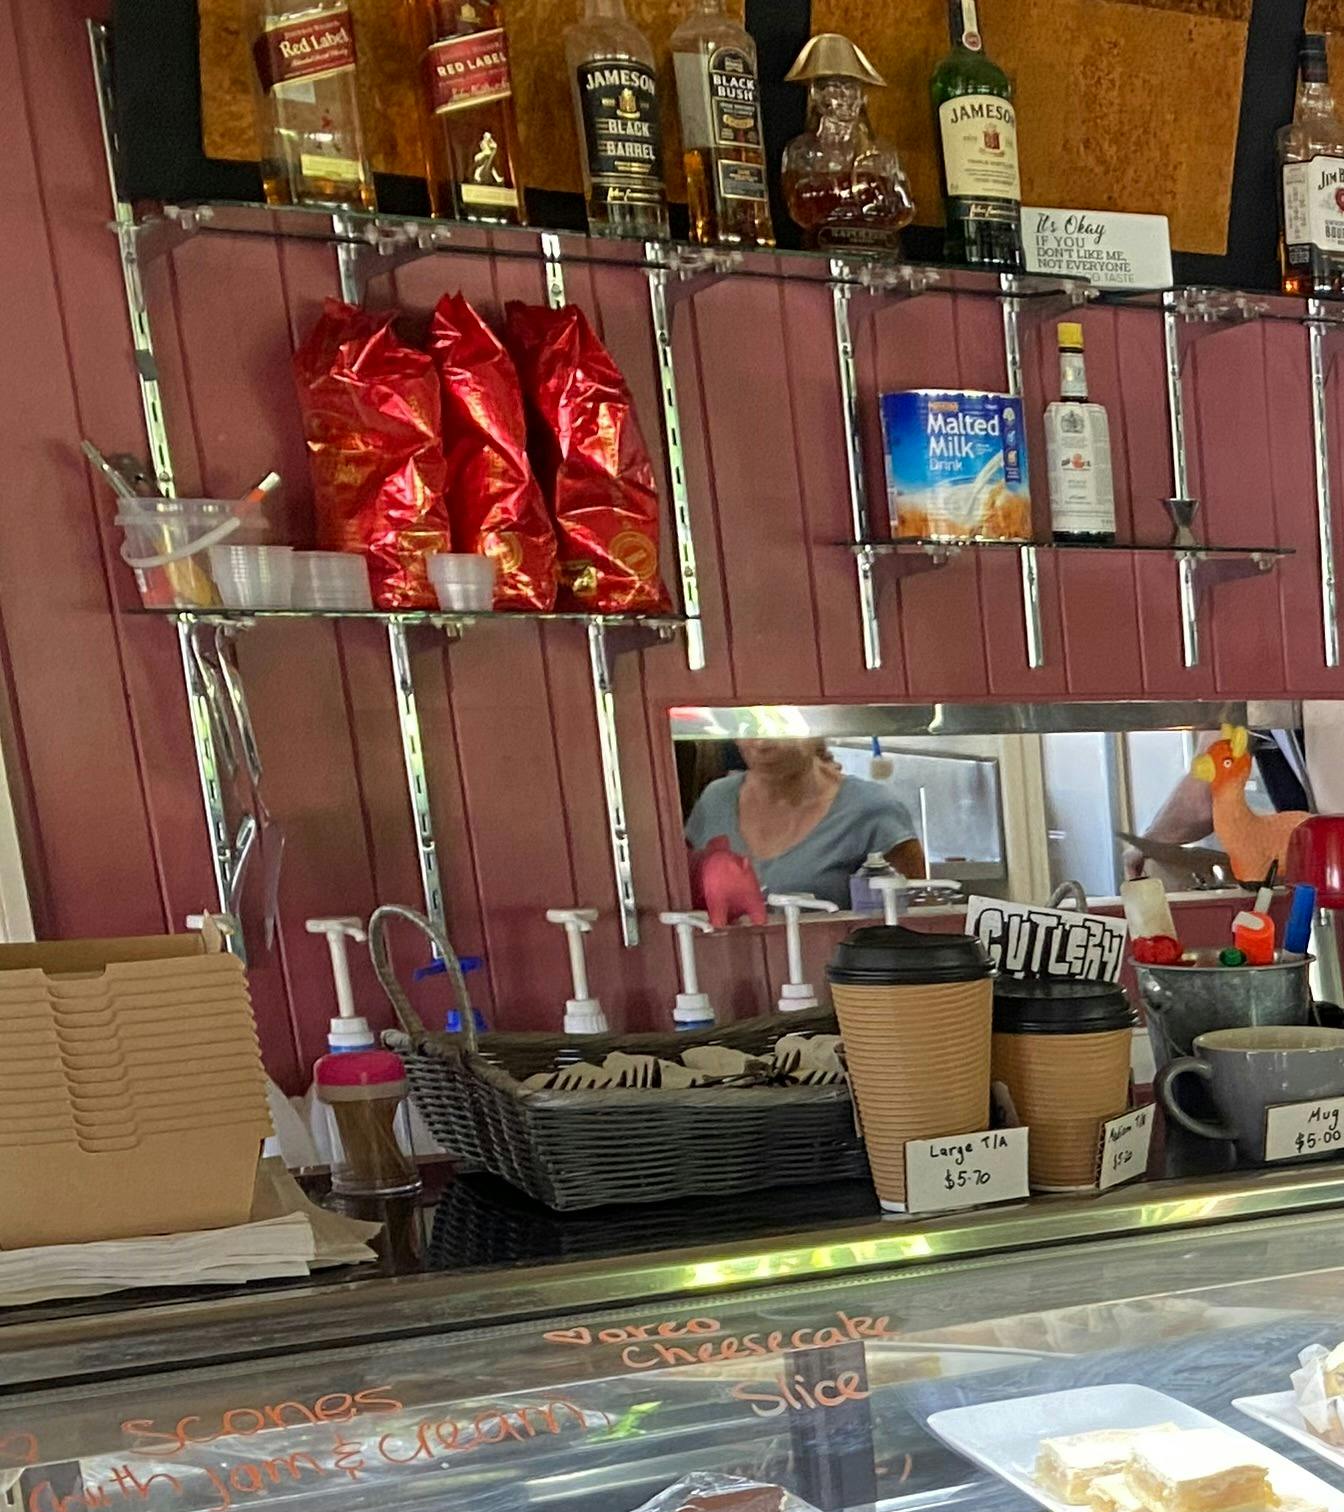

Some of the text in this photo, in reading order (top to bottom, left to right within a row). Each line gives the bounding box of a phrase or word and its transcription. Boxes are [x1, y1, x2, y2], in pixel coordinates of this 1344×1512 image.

[280, 28, 350, 58] Red Label
[437, 52, 507, 77] RED LABEL
[579, 70, 655, 95] JAMESON
[714, 75, 755, 90] BLACK
[718, 86, 753, 100] BUSH
[608, 119, 650, 136] BLACK
[606, 143, 656, 159] BARREL
[1318, 171, 1337, 190] JIM
[1064, 215, 1106, 245] Okay
[1036, 235, 1085, 248] IF YOU
[1077, 248, 1104, 260] LIKE
[1038, 258, 1131, 273] NOT EVERYONE
[928, 414, 1000, 437] Malted
[929, 436, 975, 458] Milk
[929, 458, 962, 471] Drink
[973, 906, 1124, 983] CUTLERY
[1308, 1106, 1340, 1131] Mug
[930, 1135, 1008, 1166] Large T/A
[598, 1317, 721, 1344] oreo
[333, 1433, 366, 1480] &
